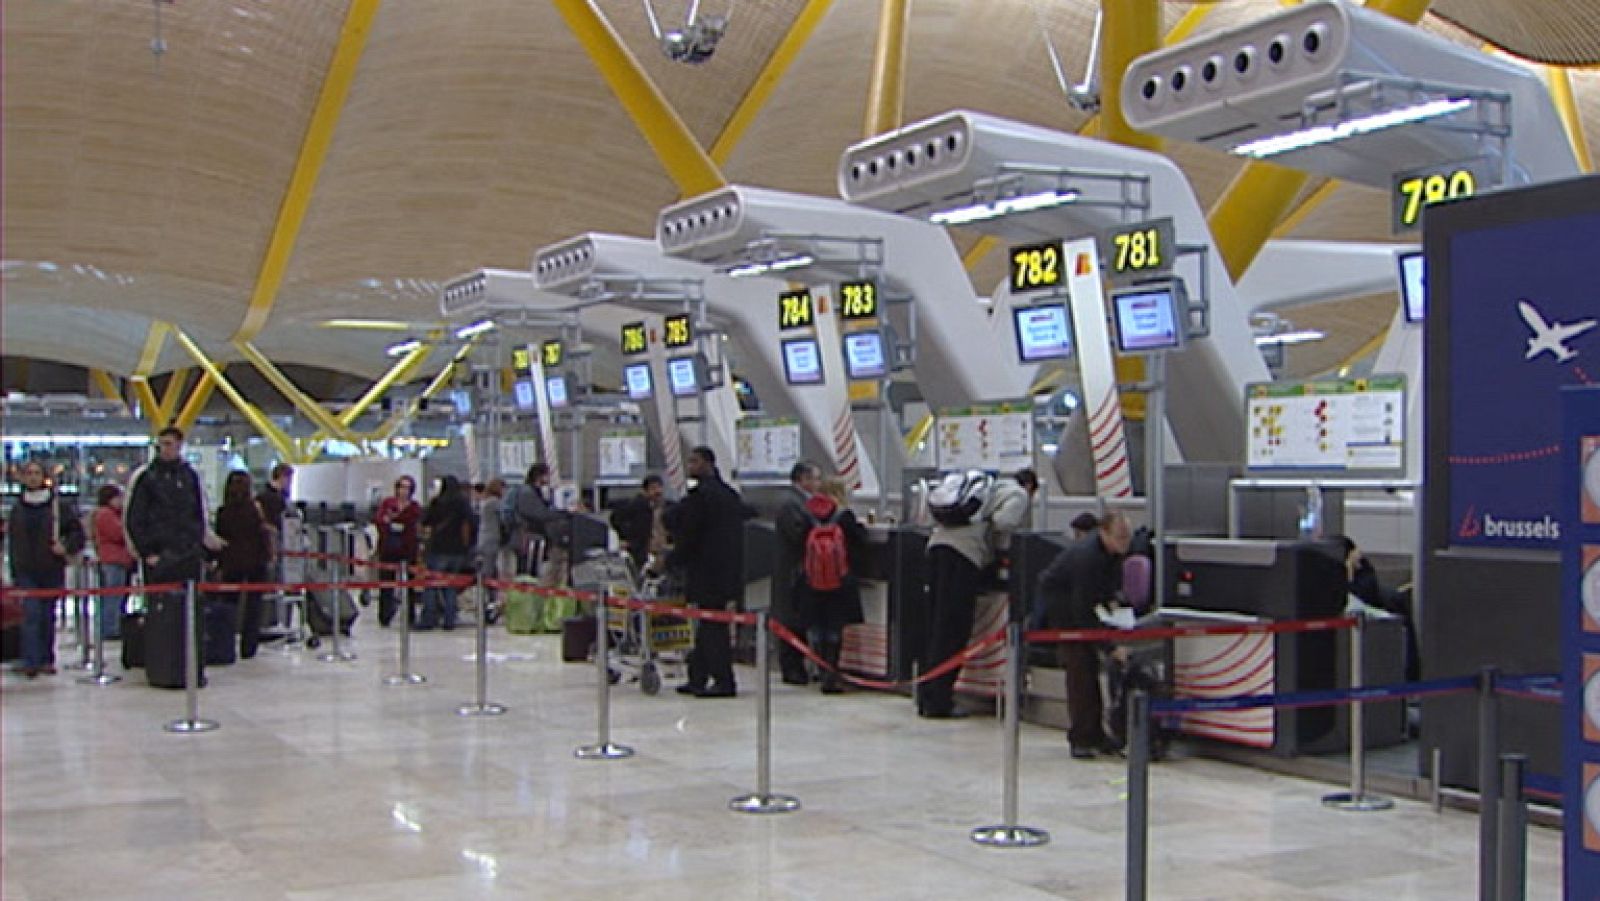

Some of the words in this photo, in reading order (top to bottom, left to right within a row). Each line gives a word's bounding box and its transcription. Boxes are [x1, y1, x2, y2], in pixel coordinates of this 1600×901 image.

[1401, 169, 1474, 224] 780
[1114, 229, 1160, 270] 781
[1014, 248, 1058, 287] 782
[782, 296, 810, 326] 784
[843, 284, 874, 315] 783
[668, 319, 689, 343] 785
[1484, 513, 1560, 539] brussels
